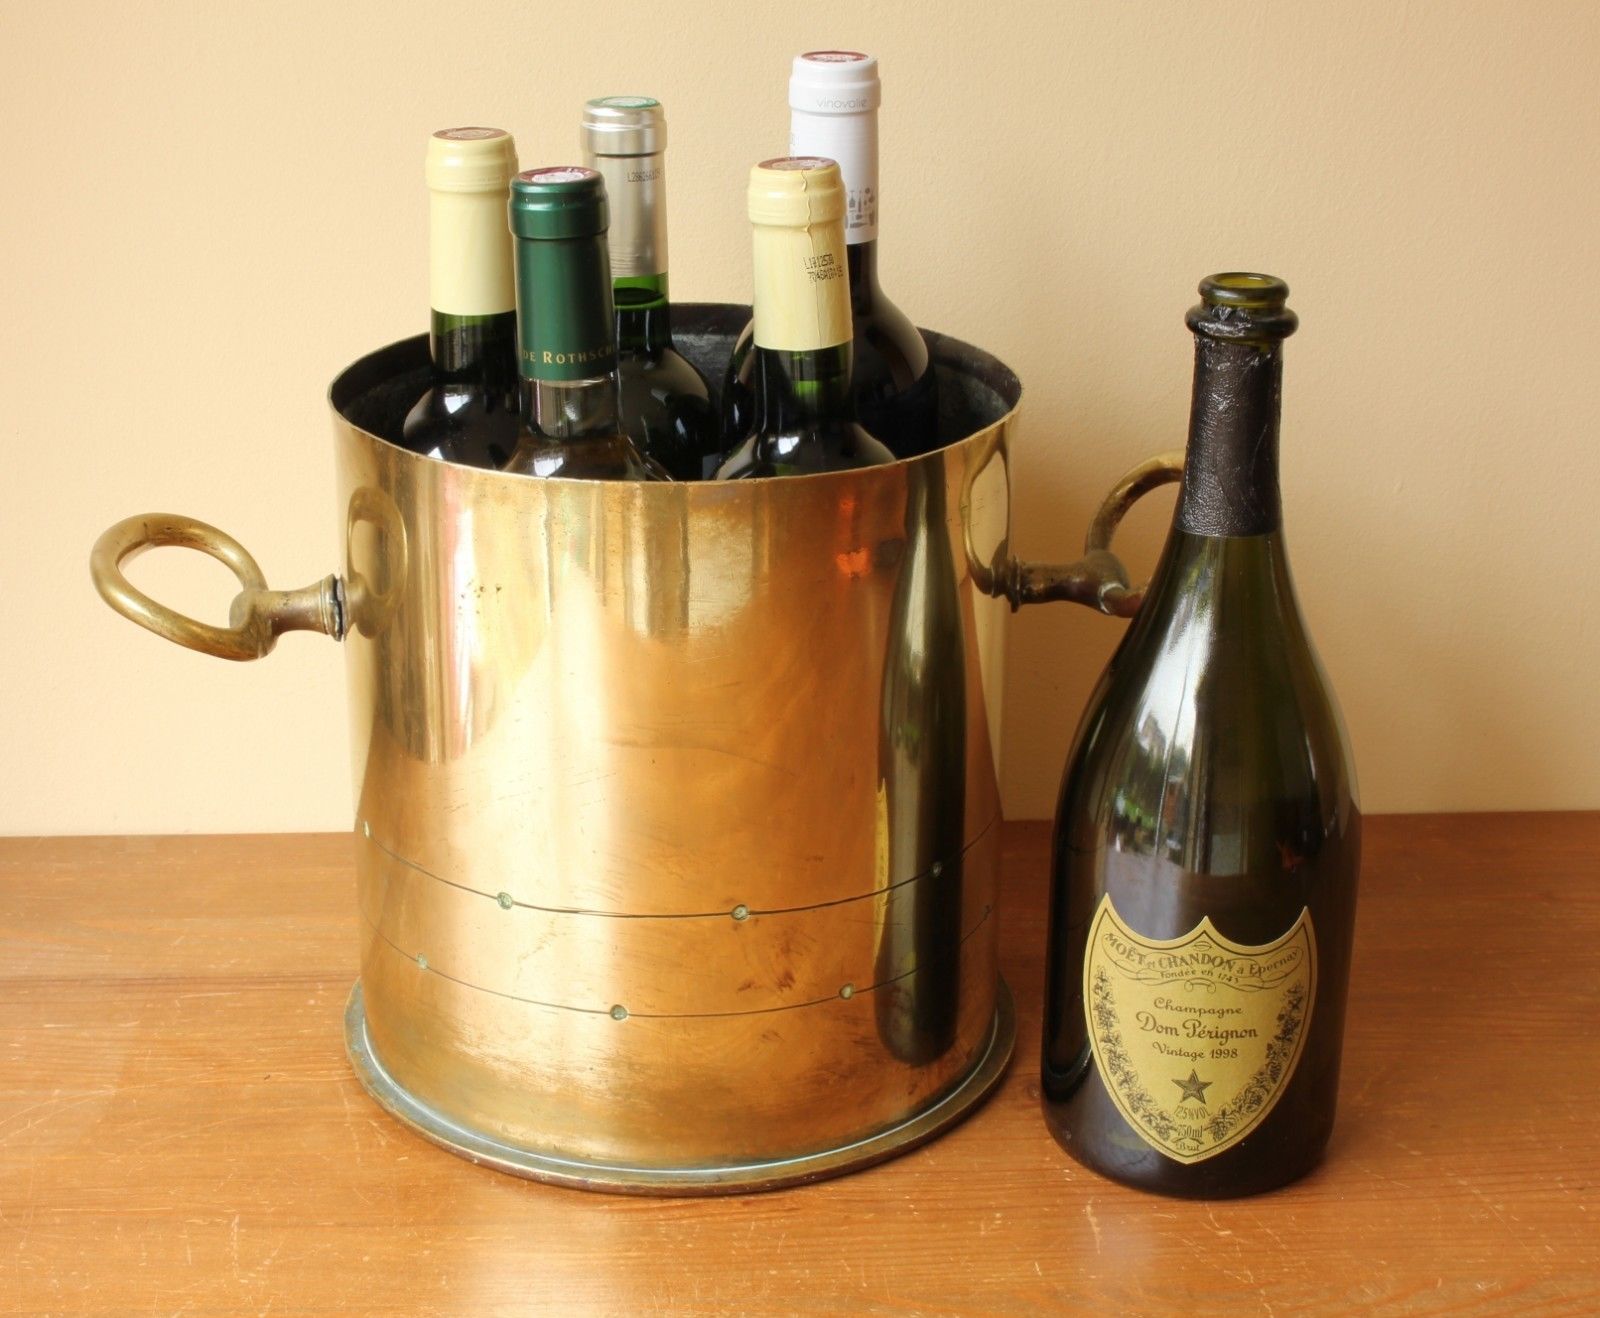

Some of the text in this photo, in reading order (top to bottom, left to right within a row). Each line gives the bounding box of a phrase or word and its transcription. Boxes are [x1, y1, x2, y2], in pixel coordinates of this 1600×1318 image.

[1158, 953, 1236, 973] CHANDON
[1153, 997, 1243, 1019] Champagne
[1135, 1010, 1259, 1046] Dom Pérignon
[1152, 1041, 1239, 1062] Vintage 1998
